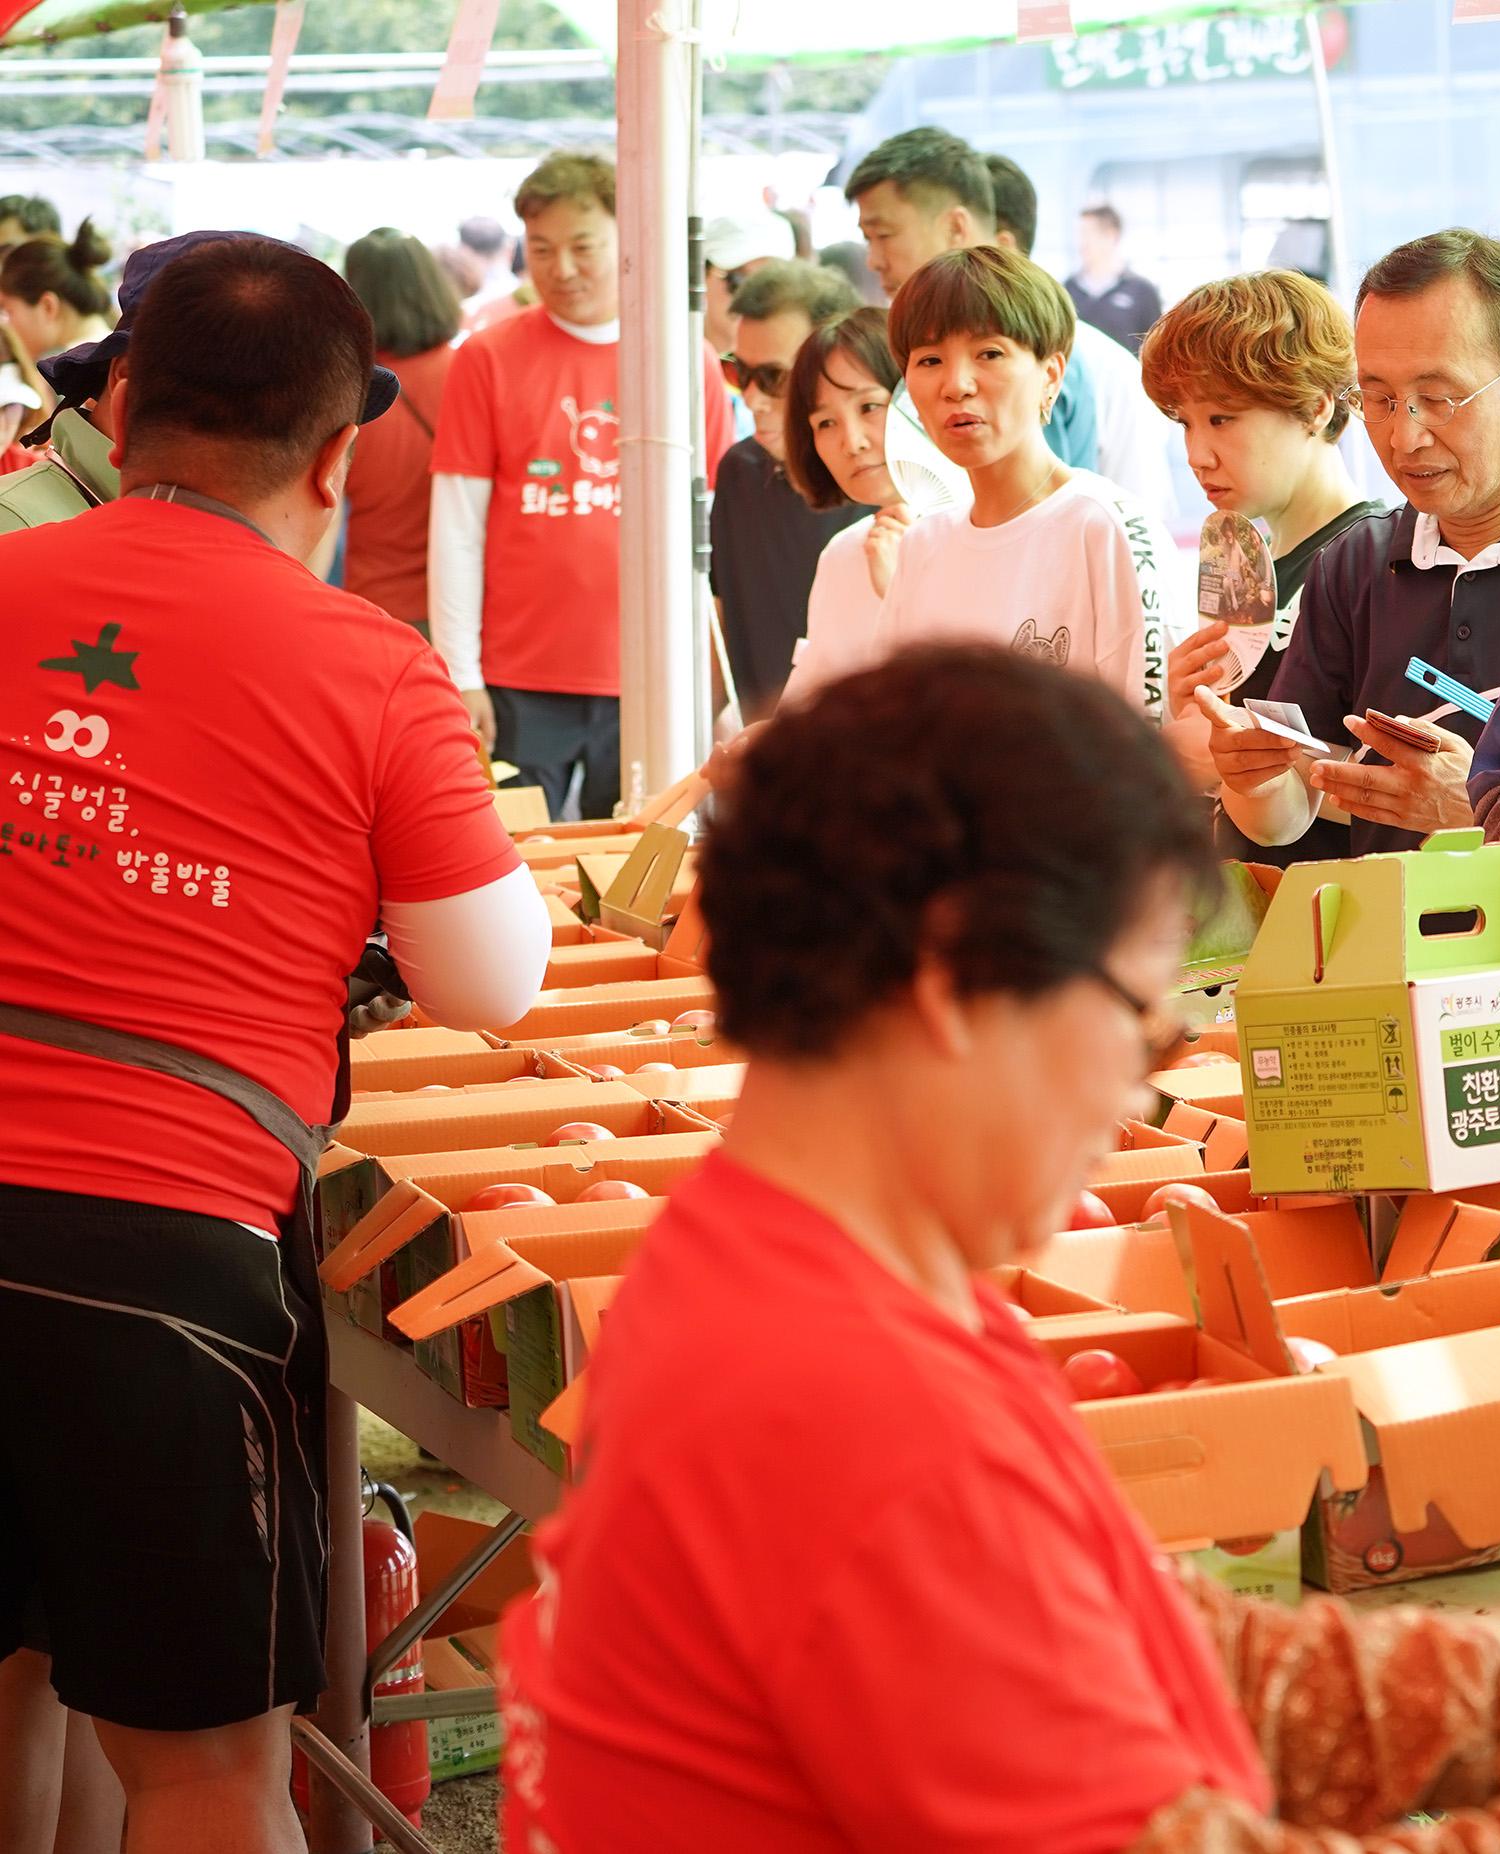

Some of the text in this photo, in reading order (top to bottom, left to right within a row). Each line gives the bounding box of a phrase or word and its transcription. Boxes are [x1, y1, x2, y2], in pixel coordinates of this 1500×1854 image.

[9, 770, 140, 836] 싱글벙글,
[0, 822, 232, 908] 토마토가 방울방울
[1455, 995, 1483, 1010] 광주시
[1449, 1031, 1477, 1058] 벌이
